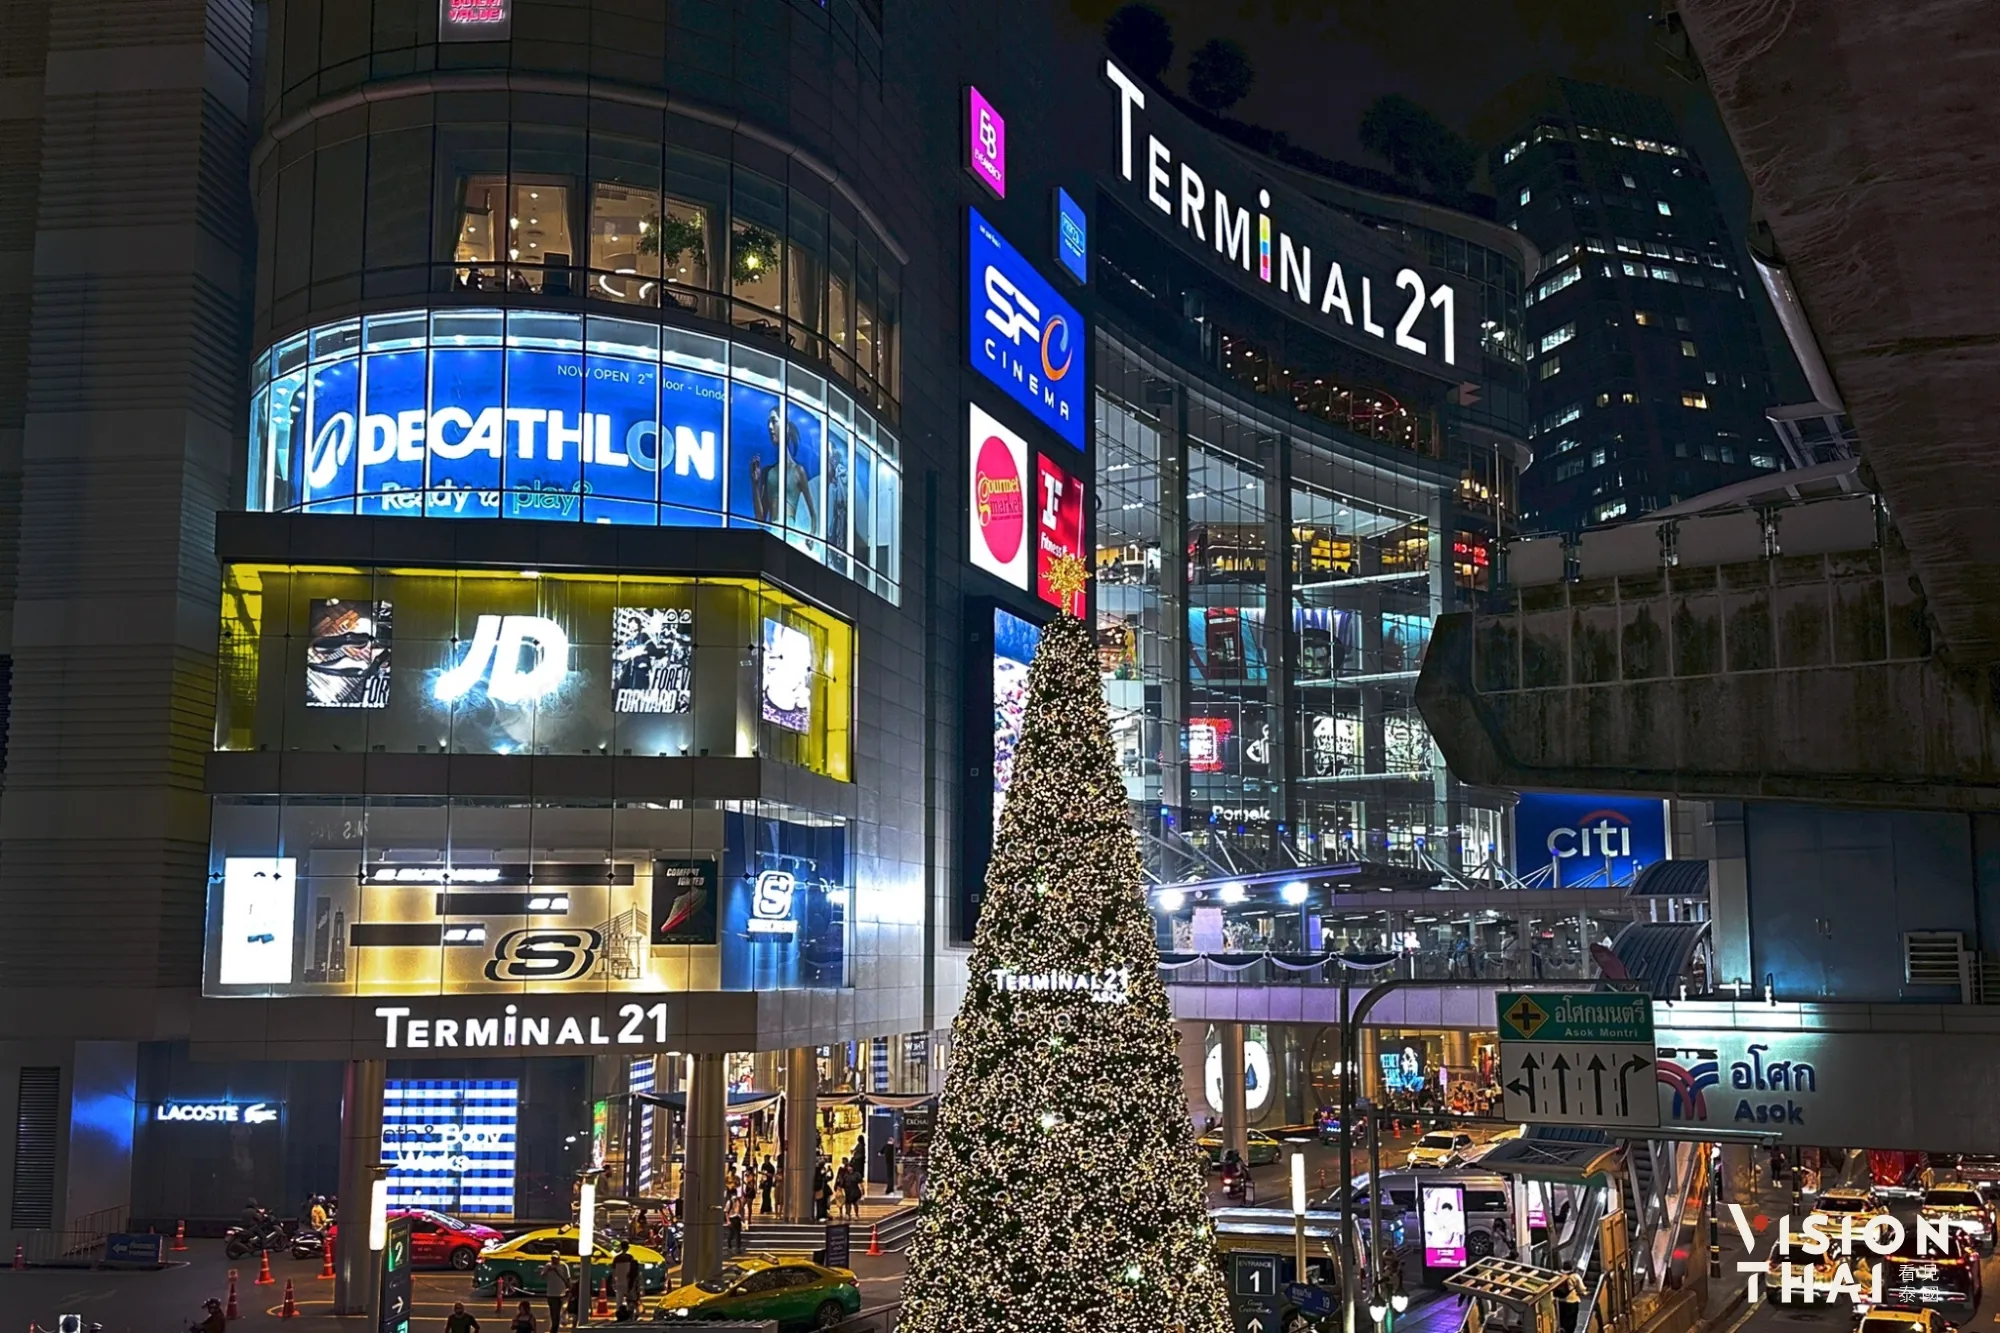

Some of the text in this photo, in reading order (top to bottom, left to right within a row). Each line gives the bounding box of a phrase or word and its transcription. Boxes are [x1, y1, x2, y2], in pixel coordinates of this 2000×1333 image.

[1396, 268, 1455, 366] 21
[557, 364, 591, 378] NOW
[593, 367, 630, 383] OPEN
[662, 377, 685, 391] loor
[985, 339, 1070, 420] CINEMA
[361, 406, 716, 481] DECATHLON
[381, 479, 467, 512] Ready
[434, 615, 569, 703] JD
[1546, 819, 1631, 858] citi
[375, 1002, 667, 1048] TERMINAL 21
[1555, 994, 1646, 1024] อโศกมนตรี
[1564, 1028, 1638, 1037] Asok Montri
[1731, 1043, 1816, 1092] อโศก
[157, 1104, 239, 1121] LACOSTE
[1734, 1099, 1805, 1125] Asok
[1249, 1269, 1260, 1293] 1
